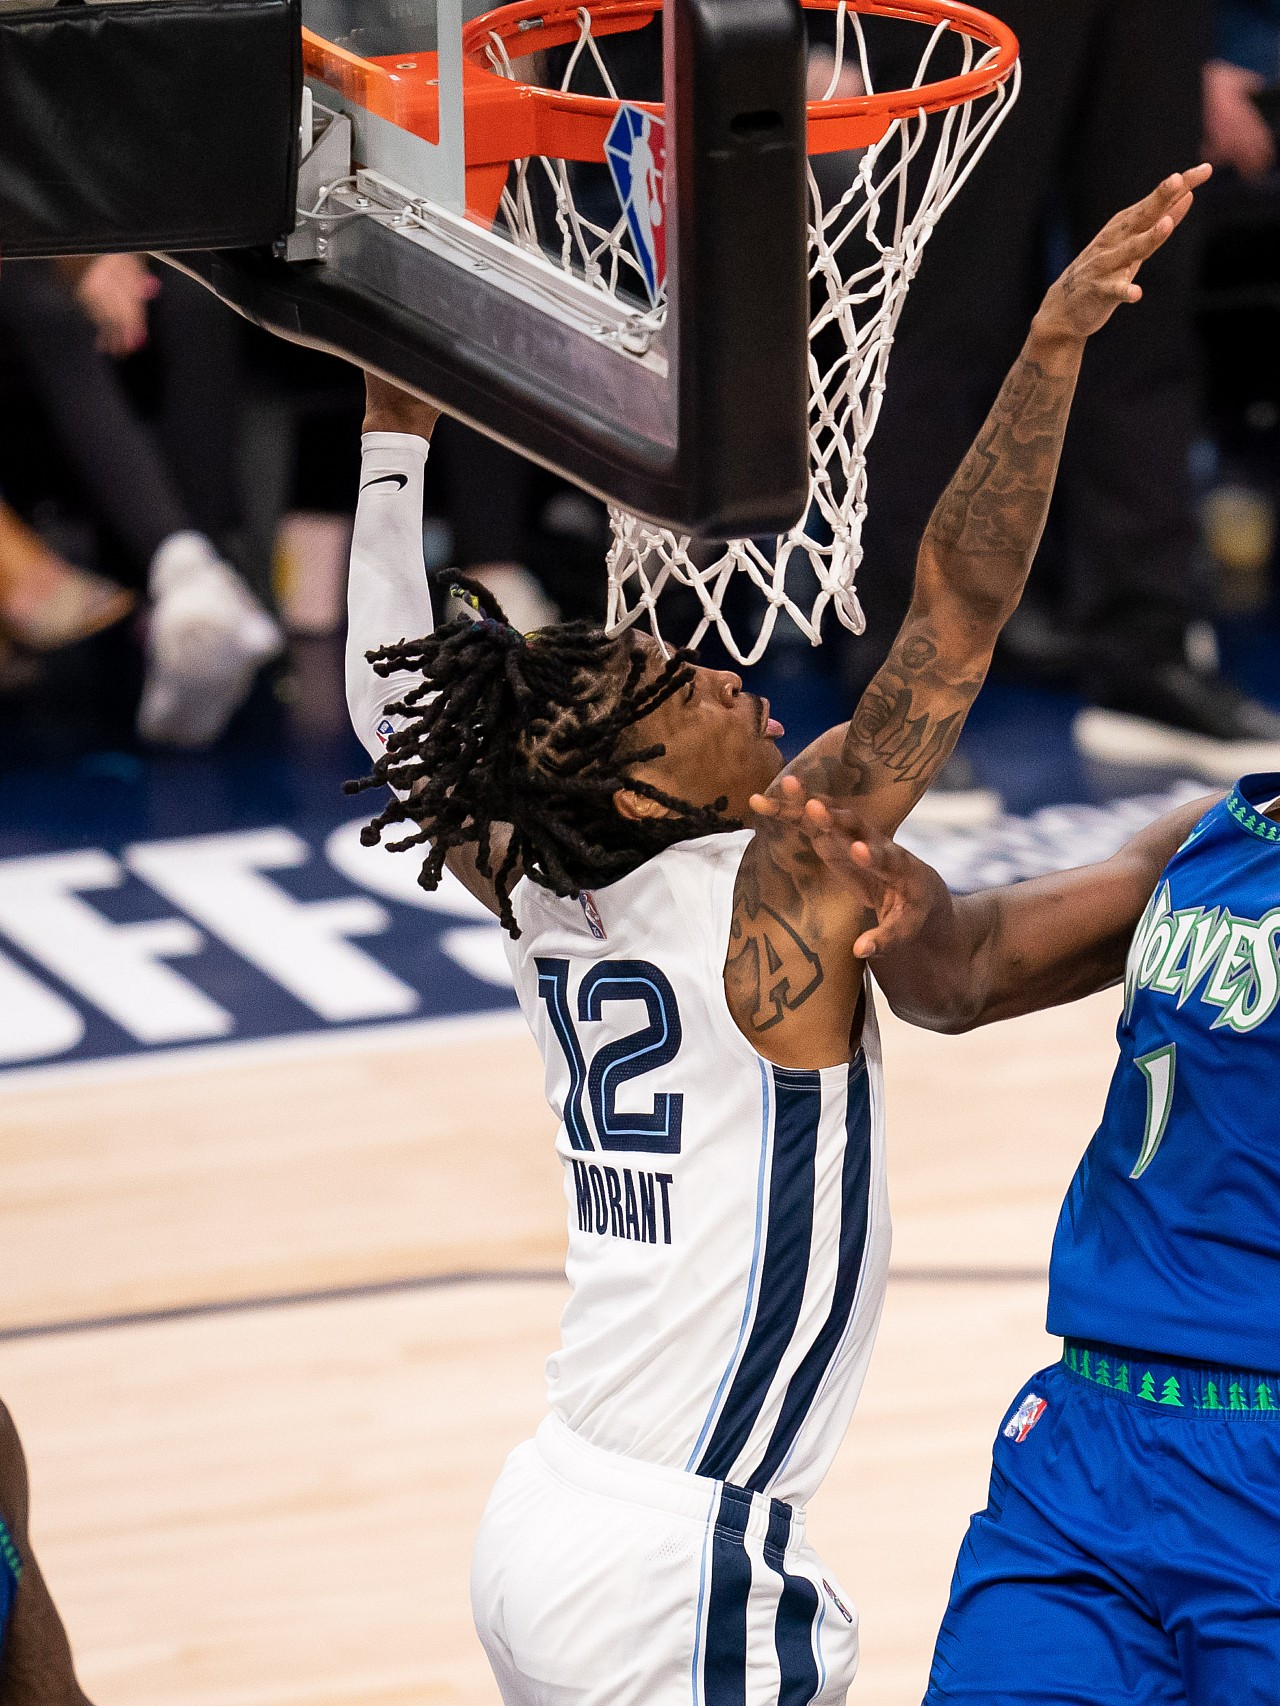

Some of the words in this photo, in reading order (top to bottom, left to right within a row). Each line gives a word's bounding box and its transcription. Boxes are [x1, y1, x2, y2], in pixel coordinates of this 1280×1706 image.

[533, 956, 684, 1155] 12
[1128, 1041, 1177, 1180] 1
[570, 1158, 674, 1245] MORANT
